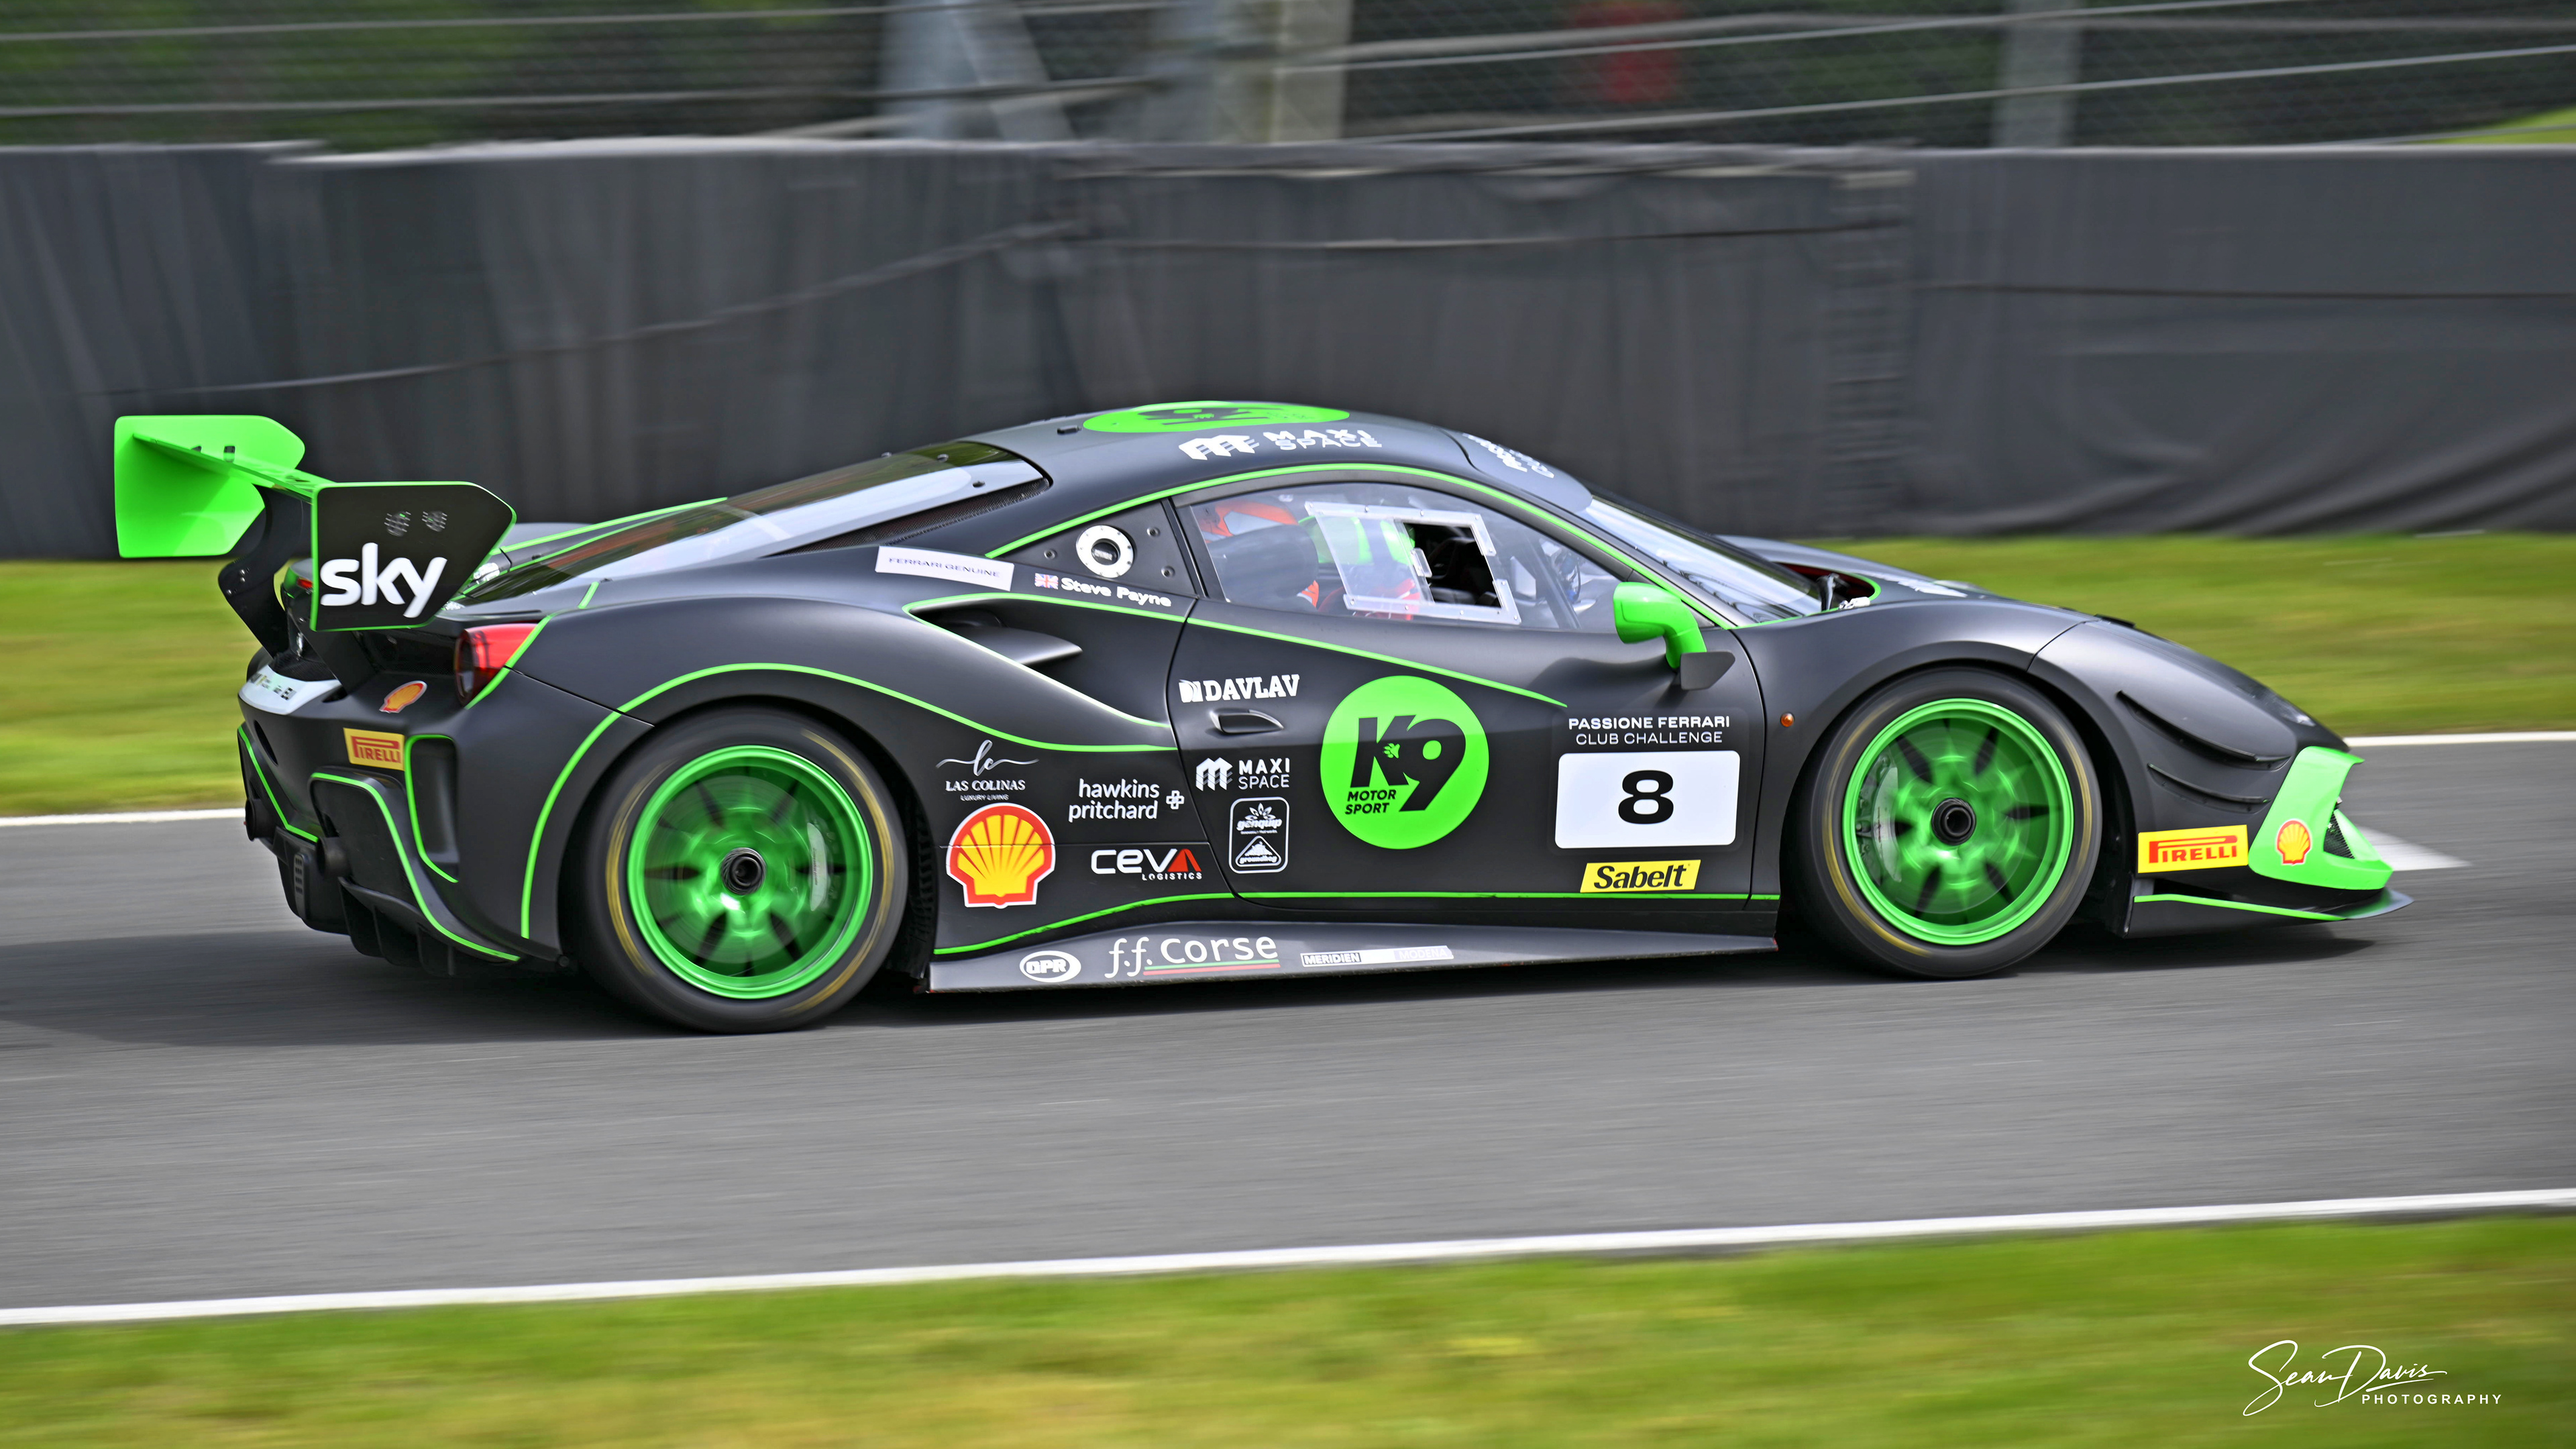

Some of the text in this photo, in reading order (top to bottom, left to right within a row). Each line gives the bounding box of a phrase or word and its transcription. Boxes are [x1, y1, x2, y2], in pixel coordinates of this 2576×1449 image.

[1263, 429, 1372, 441] MAXI
[1274, 437, 1382, 450] SPACE
[889, 557, 1000, 577] FERRARI GENUINE
[320, 542, 447, 618] sky
[1061, 578, 1172, 608] Steve Payne
[1203, 674, 1300, 702] DAVLAV
[1568, 715, 1730, 730] PASSIONE FERRARI
[1576, 731, 1723, 745] CLUB CHALLENGE
[350, 735, 401, 764] PIRELLI
[1238, 757, 1290, 775] MAXI
[1350, 714, 1466, 812] K9
[945, 780, 1026, 792] LAS COLINAS
[1079, 778, 1160, 798] hawkins
[1238, 774, 1290, 790] SPACE
[1347, 790, 1397, 802] MOTOR
[1618, 769, 1674, 825] 8
[1068, 800, 1159, 823] pritchard
[1345, 802, 1389, 814] SPORT
[2149, 835, 2238, 863] PIRELLI
[1142, 872, 1203, 881] LOGISTICS
[1593, 864, 1687, 890] Sabelt
[1160, 936, 1279, 964] Corse
[1304, 953, 1360, 965] MERIDIEN
[1399, 948, 1448, 960] MODENA
